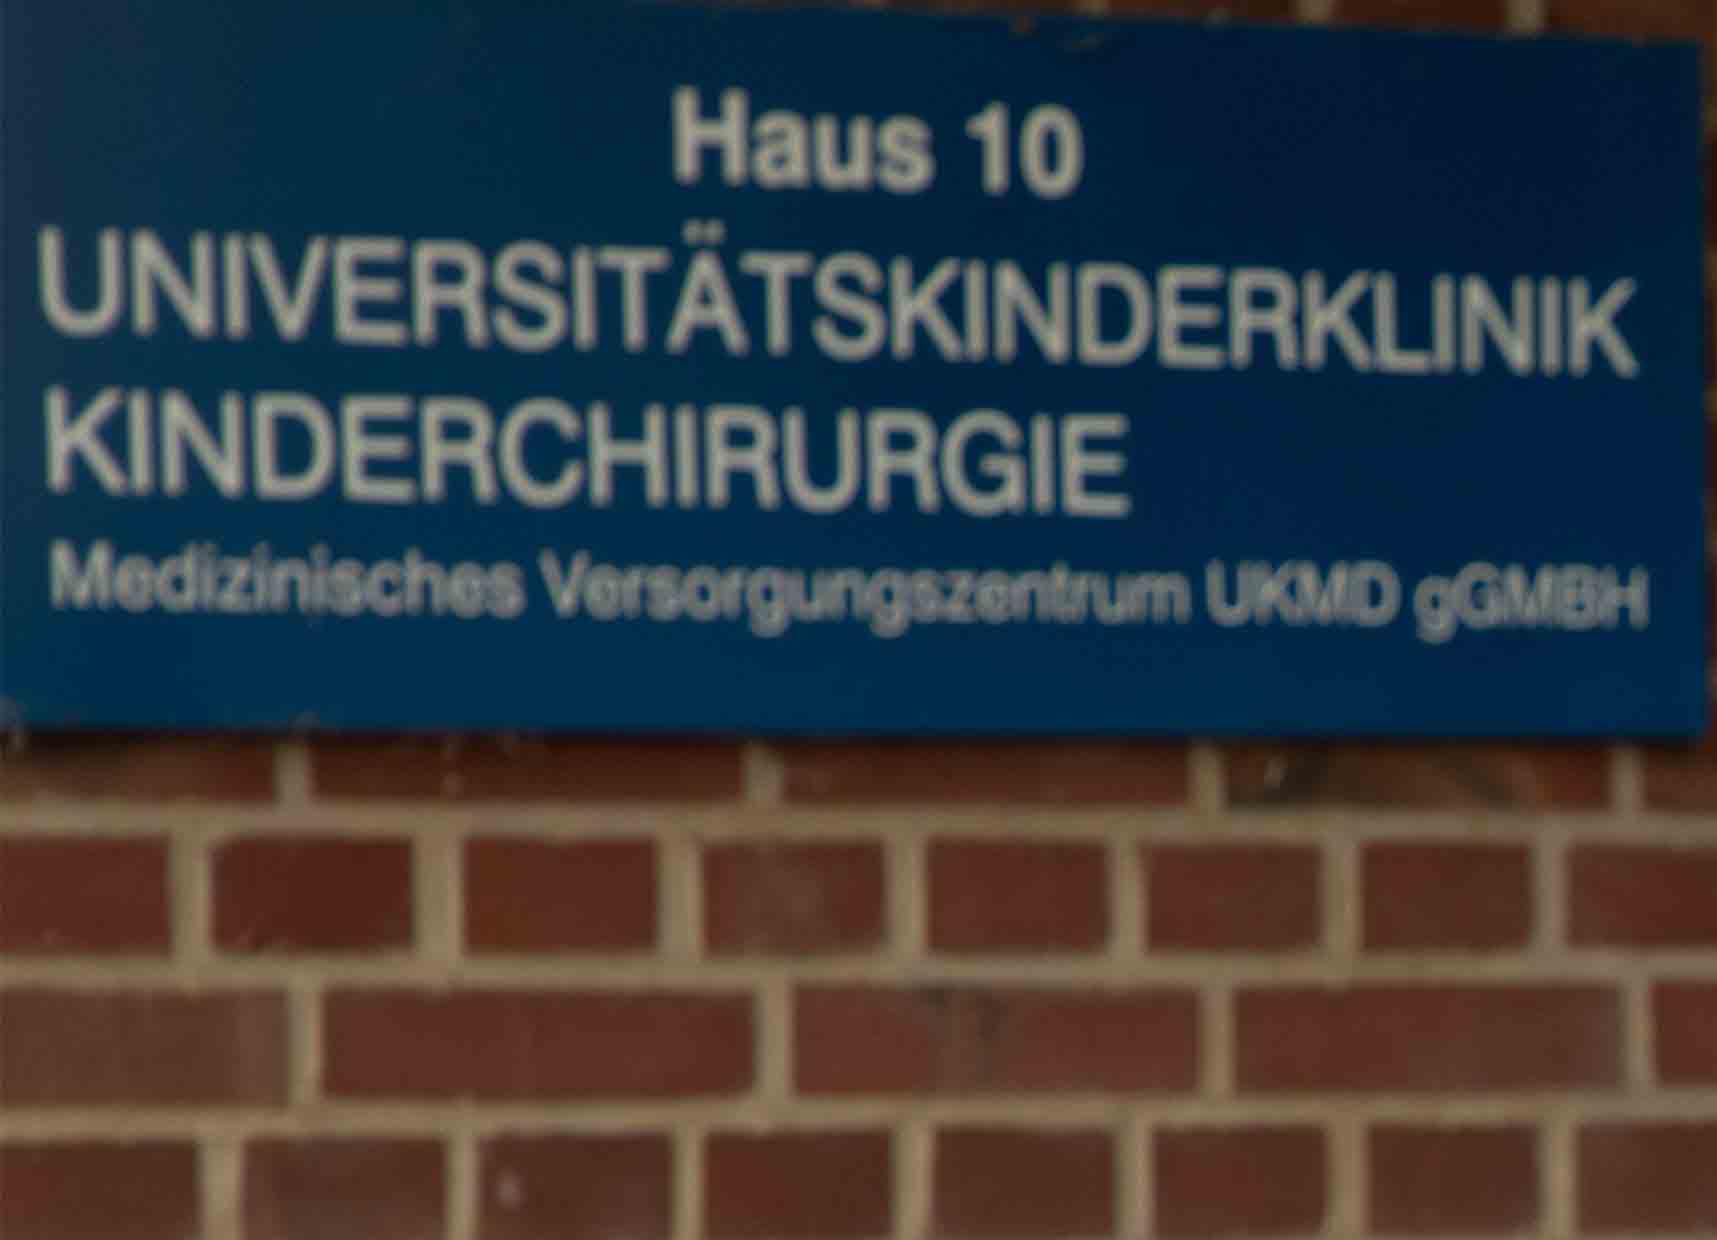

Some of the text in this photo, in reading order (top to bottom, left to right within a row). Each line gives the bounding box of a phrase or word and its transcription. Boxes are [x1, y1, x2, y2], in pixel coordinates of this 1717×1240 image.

[674, 86, 1083, 197] Haus 10
[37, 220, 1638, 378] UNIVERSITÄTSKINDERKLINIK
[44, 386, 1131, 517] KINDERCHIRURGIE
[49, 539, 1649, 643] Medizinisches Versorgungszentrum UKMD gGMBH
